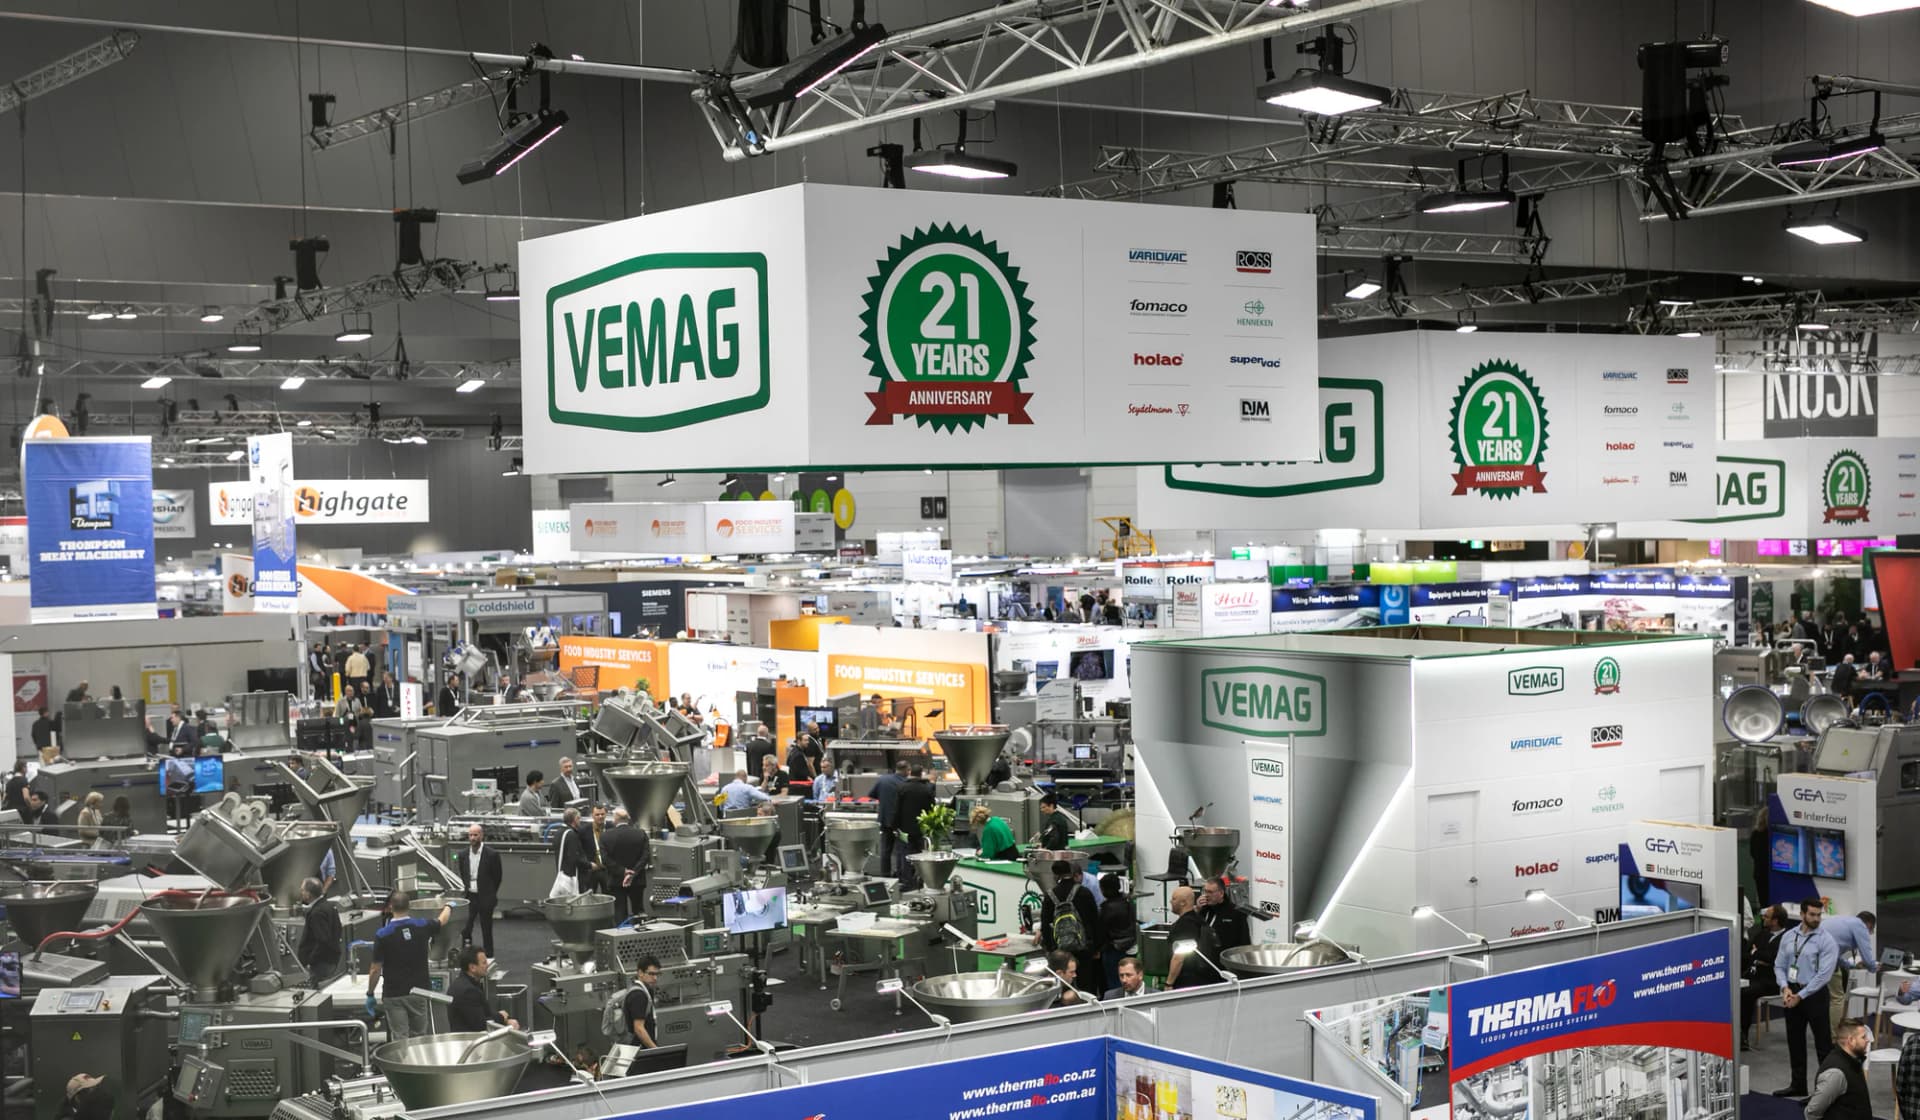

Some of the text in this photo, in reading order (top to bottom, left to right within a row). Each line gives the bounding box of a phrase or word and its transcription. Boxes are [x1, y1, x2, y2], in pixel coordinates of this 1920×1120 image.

[1128, 250, 1188, 263] VARIOVAC
[1236, 251, 1271, 268] ROSS
[919, 270, 981, 341] 21
[1129, 299, 1188, 314] fomaco
[1236, 318, 1274, 328] HENNEKEN
[563, 287, 741, 393] VEMAG
[910, 343, 991, 377] YEARS
[1133, 353, 1183, 367] holac
[1766, 329, 1875, 421] KIOSK
[908, 389, 993, 405] ANNIVERSARY
[1127, 403, 1173, 417] Seydelmann
[1241, 400, 1270, 417] DJM
[1481, 391, 1518, 438] 21
[1603, 403, 1639, 415] fomaco
[1476, 439, 1523, 463] YEARS
[1605, 441, 1636, 451] holac
[1475, 470, 1525, 482] ANNIVERSARY
[1837, 466, 1857, 492] 21
[297, 487, 409, 518] highgate
[1835, 492, 1859, 506] YEARS
[537, 521, 570, 534] SIEMENS
[735, 526, 783, 535] SERVICES
[59, 539, 126, 551] THOMPSON
[40, 549, 145, 562] MEAT MACHINERY
[641, 588, 672, 598] SIEMENS
[478, 600, 535, 612] coldshield
[563, 644, 652, 663] FOOD INDUSTRY SERVICES
[834, 664, 966, 688] FOOD INDUSTRY SERVICES
[1601, 664, 1613, 678] 21
[1513, 672, 1558, 690] VEMAG
[1212, 681, 1312, 722] VEMAG
[1590, 724, 1623, 743] ROSS
[1510, 736, 1564, 750] VARIOVAC
[1254, 762, 1281, 774] VEMAG
[1793, 788, 1825, 803] GEA
[1511, 797, 1564, 812] fomaco
[1803, 811, 1847, 825] Interfood
[1645, 837, 1679, 855] GEA
[1256, 849, 1281, 861] holac
[1515, 862, 1559, 878] holac
[1656, 864, 1703, 880] Interfood
[1467, 978, 1617, 1037] THERMAFLO
[1480, 1012, 1598, 1044] LIQUID FOOD PROCESS SYSTEMS
[962, 1067, 1098, 1101] www.thermaflo.co.nz
[948, 1085, 1097, 1120] www.thermaflo.com.au
